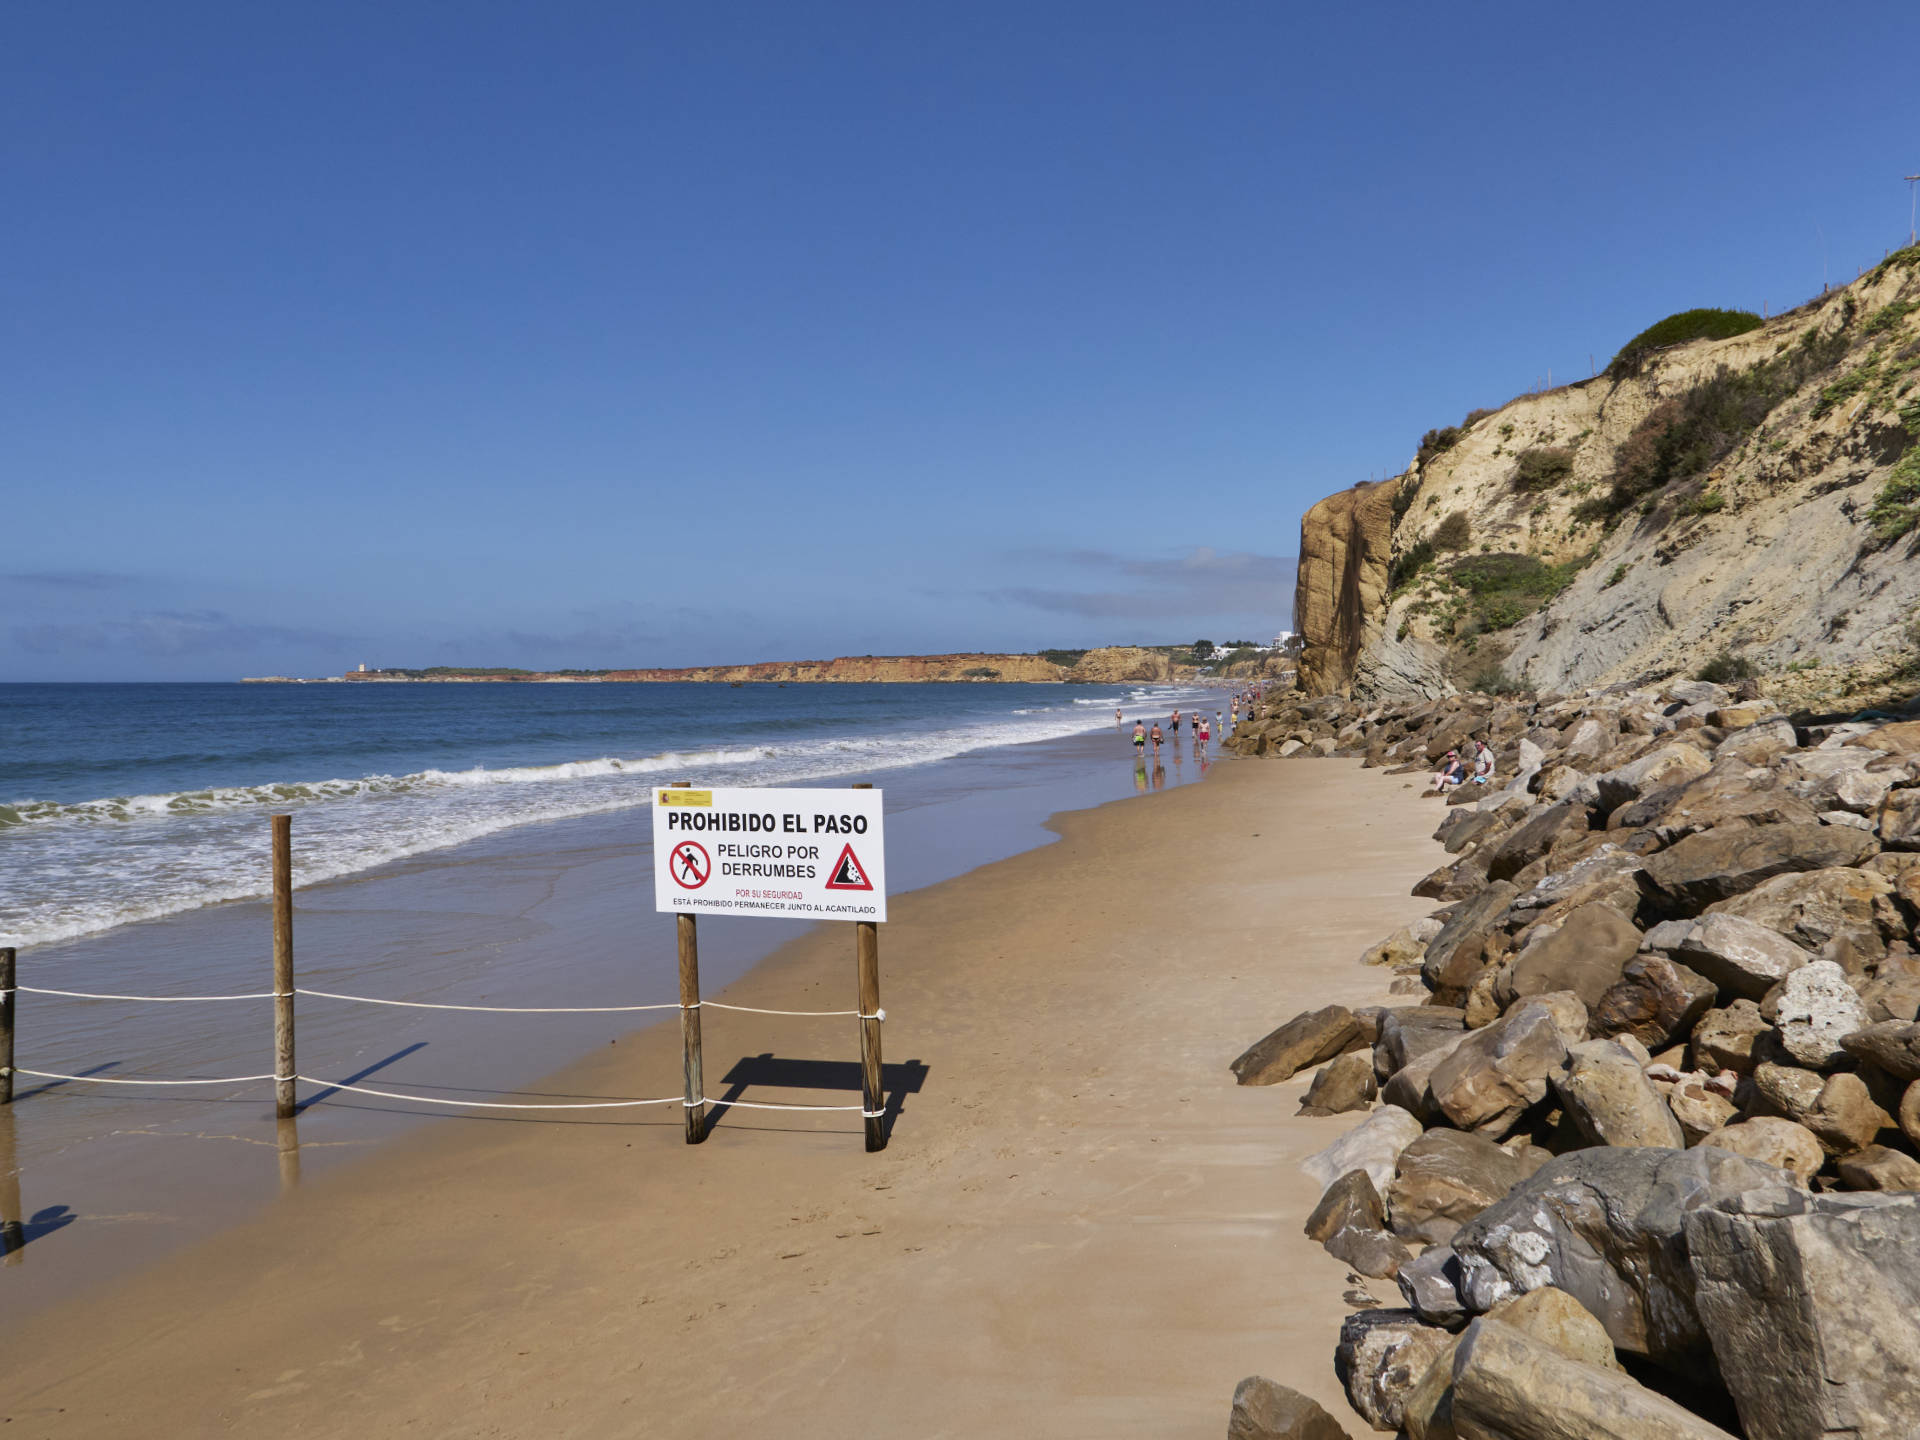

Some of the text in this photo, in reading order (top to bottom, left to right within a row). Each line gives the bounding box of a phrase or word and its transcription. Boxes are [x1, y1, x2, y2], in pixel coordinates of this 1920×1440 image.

[668, 812, 868, 835] PROHIBIDO EL PASO
[718, 844, 819, 860] PELIGRO POR
[722, 862, 816, 879] DERRUMBES
[735, 889, 803, 900] POR SU SEGURIDAD
[693, 899, 733, 908] PROHIBIDO
[735, 901, 785, 910] PERMANECER
[787, 903, 812, 911] JUNTO
[814, 904, 824, 912] AL
[825, 905, 876, 914] ACANTILADO
